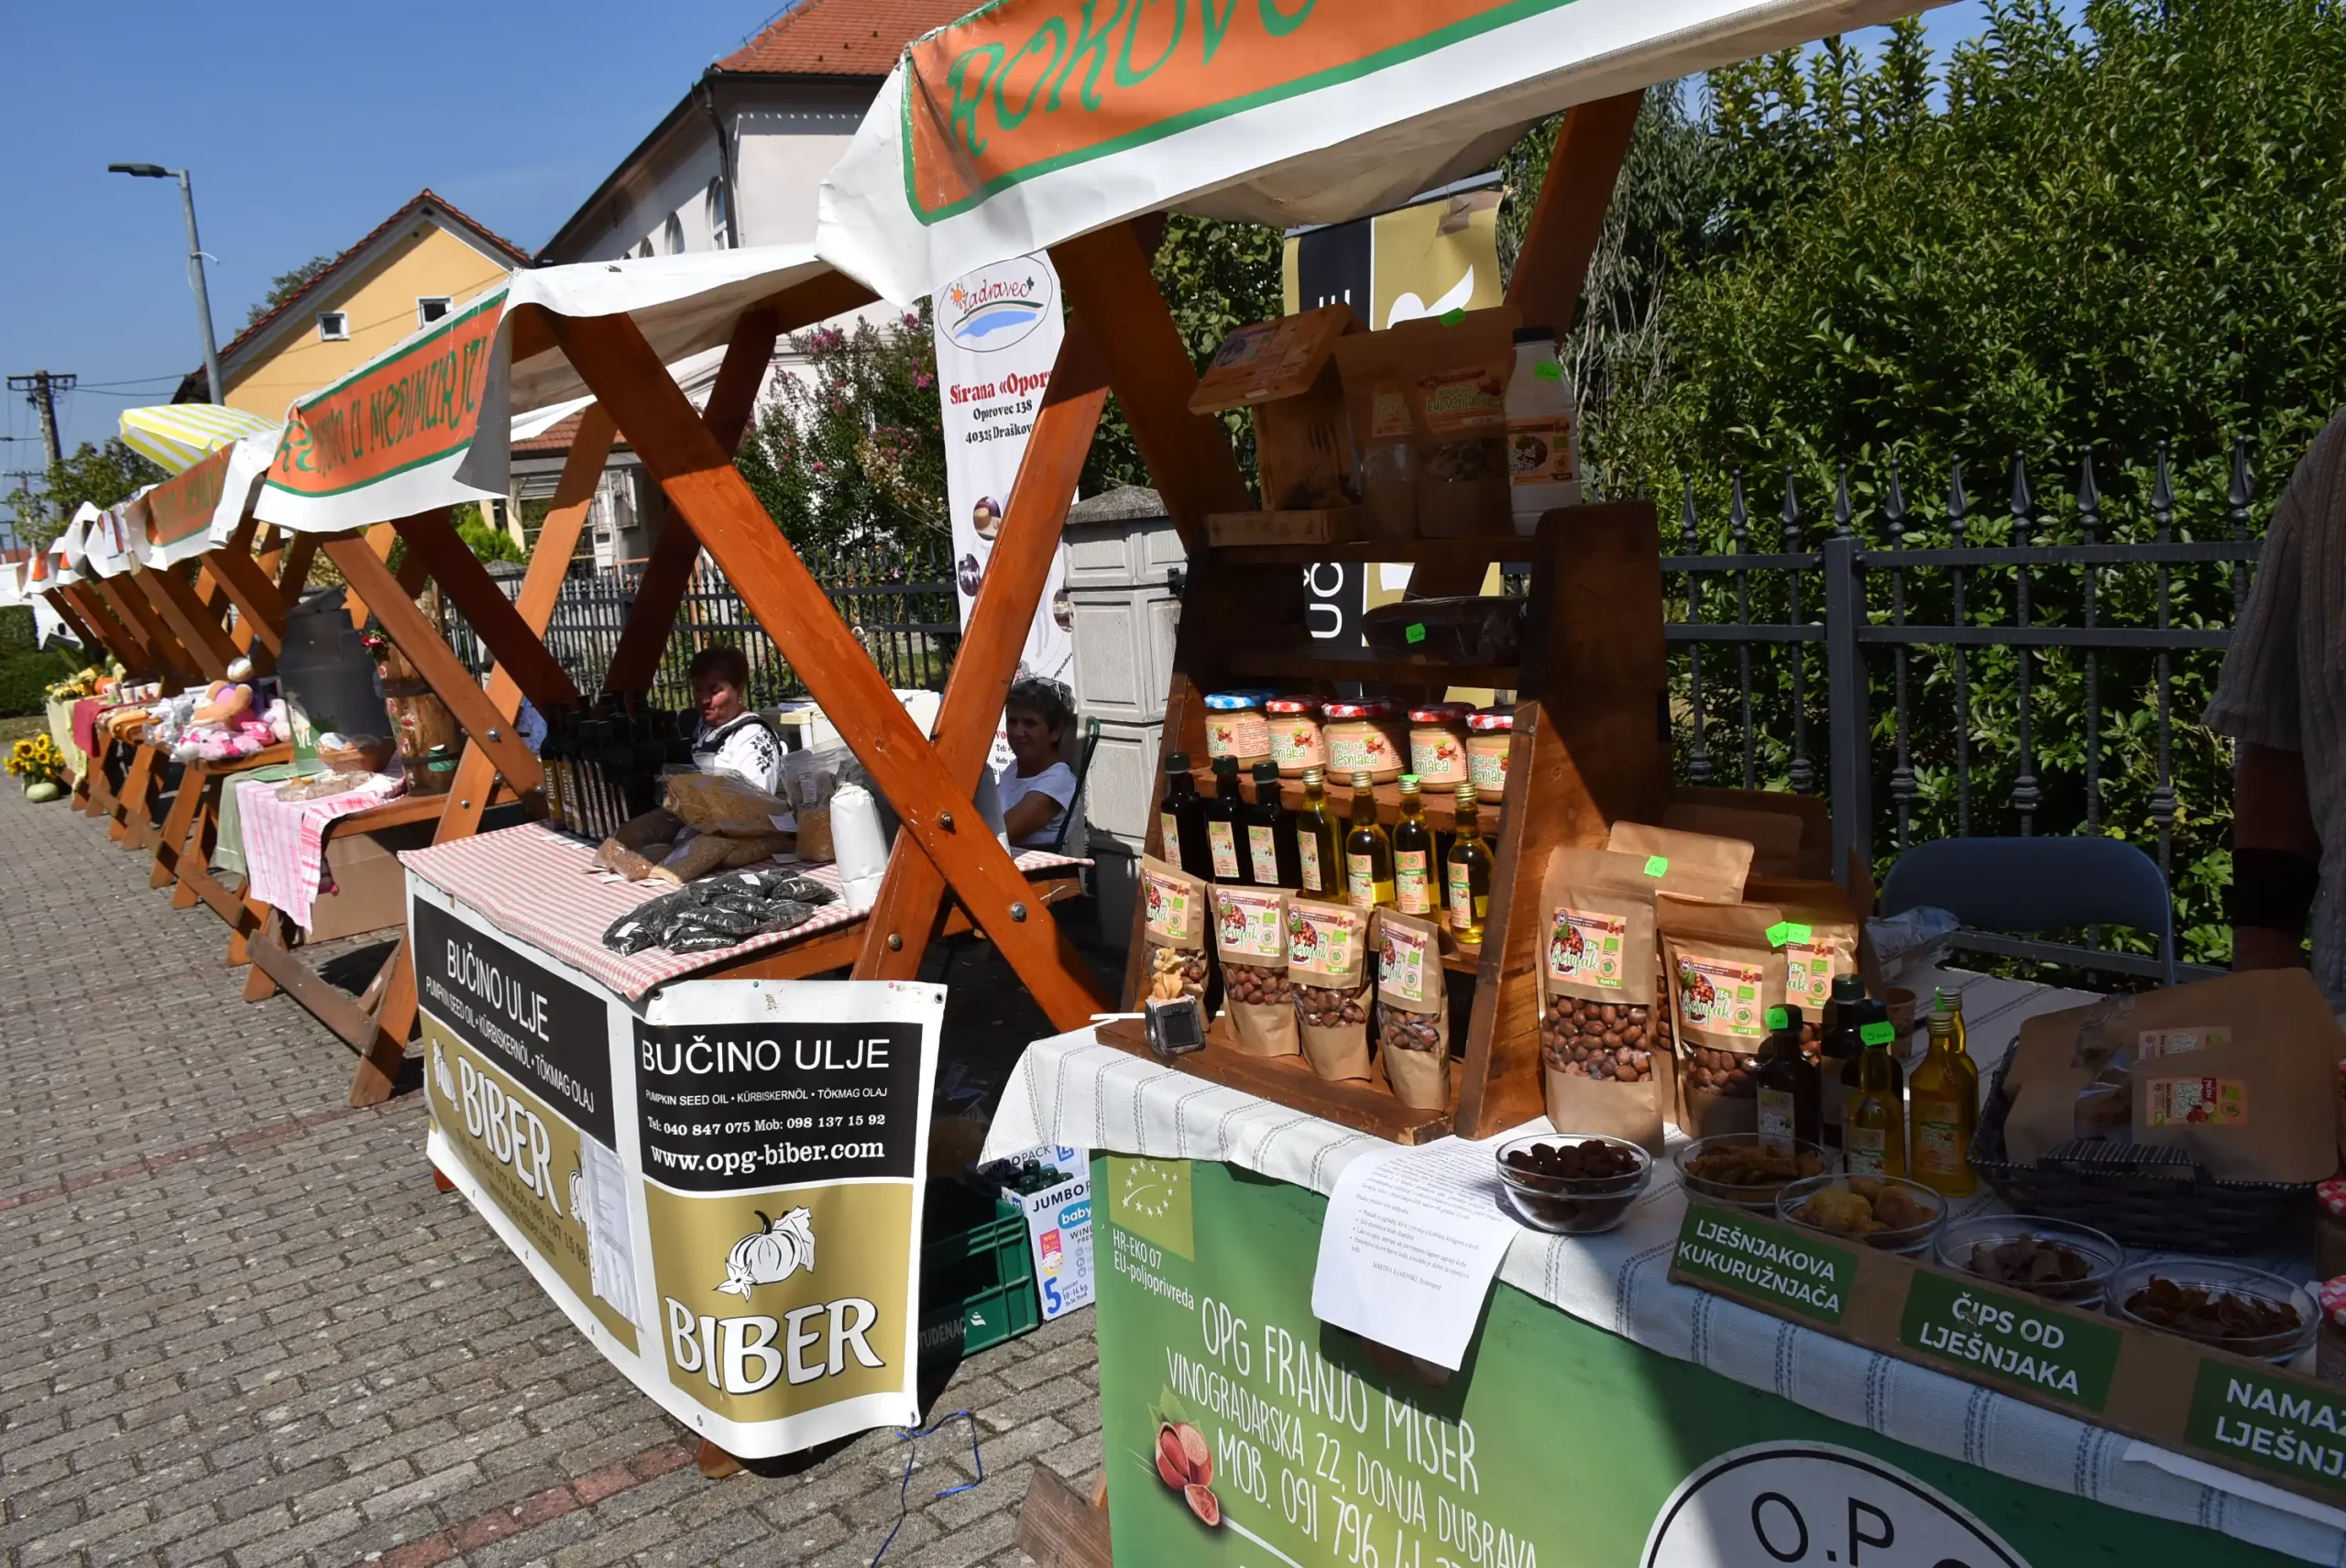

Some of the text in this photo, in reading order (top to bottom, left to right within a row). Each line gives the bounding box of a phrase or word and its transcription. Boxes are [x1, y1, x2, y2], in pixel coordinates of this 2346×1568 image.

[949, 382, 995, 405] Sirana
[973, 399, 1033, 421] Oporovec 138
[1585, 940, 1596, 950] EKO
[1791, 963, 1803, 972] EKO
[447, 938, 549, 1042] BUČINO ULJE
[1716, 989, 1729, 1000] EKO
[450, 997, 464, 1020] SEED
[465, 1004, 476, 1028] OIL
[571, 1080, 594, 1113] OLAJ
[642, 1035, 890, 1075] BUČINO ULJE
[646, 1089, 676, 1105] PUMPKIN
[680, 1095, 709, 1106] SEED
[712, 1092, 729, 1105] OIL
[862, 1087, 887, 1098] OLAJ
[648, 1114, 885, 1136] Tel: 040 847 075 Mob: 098 137 15 92
[458, 1055, 564, 1220] BIBER
[651, 1141, 885, 1176] www.opg-biber.com
[1113, 1228, 1161, 1269] HR-EKO 07
[1679, 1242, 1839, 1313] KUKURUŽNJAČA
[1697, 1220, 1835, 1281] LJEŠNJAKOVA
[1044, 1277, 1062, 1314] 5
[1114, 1251, 1194, 1310] EU-poljoprivreda
[664, 1296, 886, 1396] BIBER
[1952, 1292, 2065, 1350] ČIPS OD
[1919, 1321, 2079, 1396] LJEŠNJAKA
[1202, 1297, 1478, 1494] OPG FRANJO MISER
[1167, 1346, 1304, 1466] VINOGRADARSKA
[1317, 1432, 1345, 1493] 22,
[1357, 1451, 1426, 1532] DONJA
[2215, 1417, 2346, 1479] LJEŠNJ
[1218, 1427, 1271, 1508] MOB.
[1282, 1468, 1317, 1541] 091
